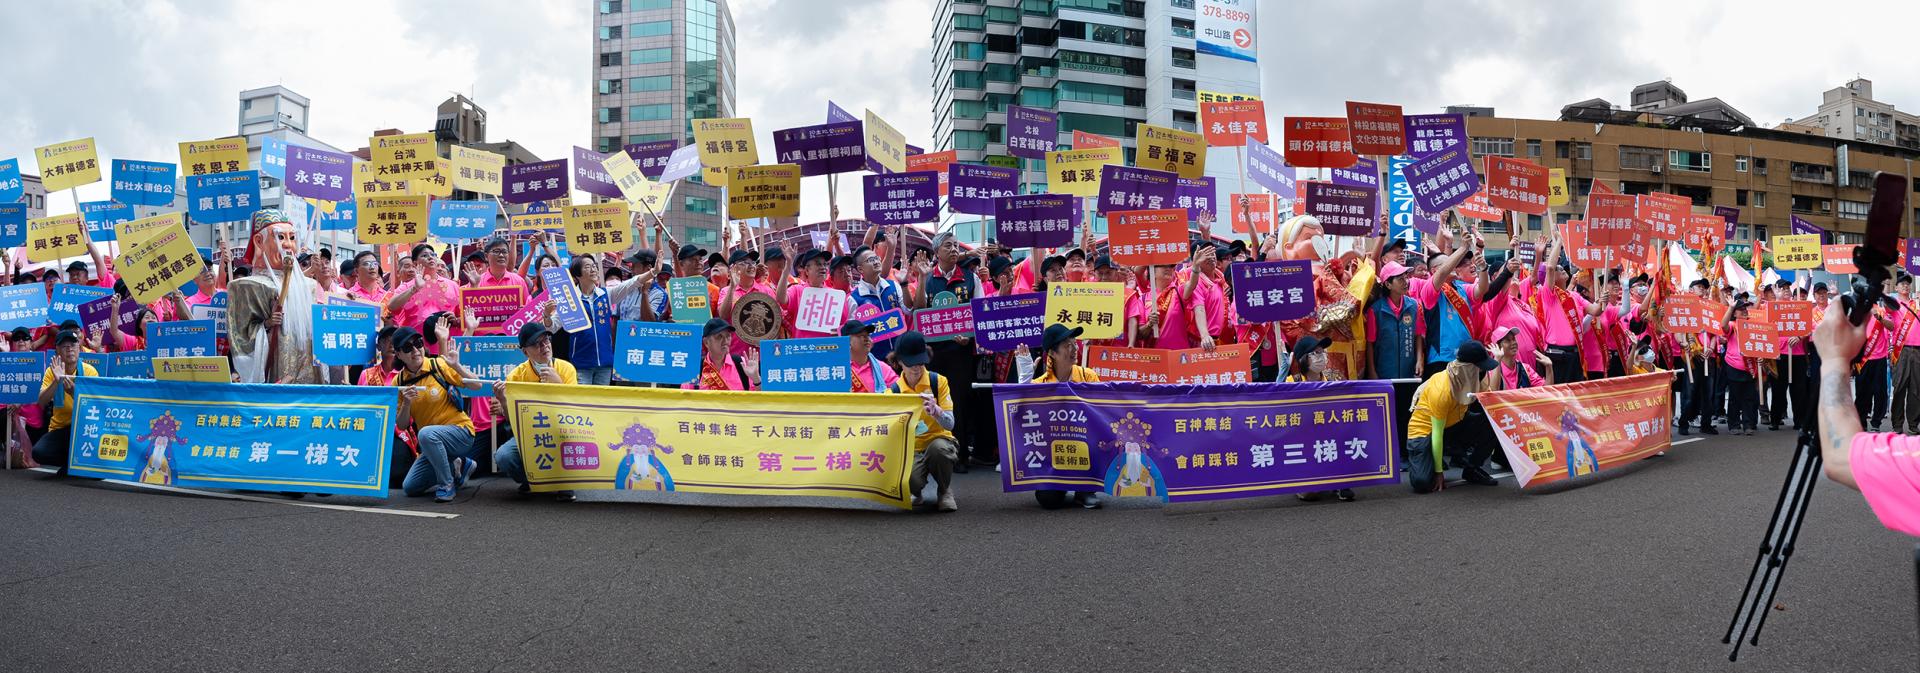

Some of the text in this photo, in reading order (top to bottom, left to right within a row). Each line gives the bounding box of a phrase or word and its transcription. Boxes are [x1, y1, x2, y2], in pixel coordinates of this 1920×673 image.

[1203, 5, 1250, 23] 378-8899
[1205, 28, 1231, 40] 中山路
[1211, 121, 1258, 135] 永佳宮
[706, 140, 748, 154] 福得宮
[1010, 135, 1053, 151] 白宮福德宮
[1289, 140, 1353, 153] 頭份福德祠
[1356, 135, 1401, 146] 文化交流協會
[1413, 138, 1458, 153] 龍德宮
[394, 149, 416, 160] 台灣
[1148, 145, 1197, 165] 晉福宮
[45, 158, 96, 178] 大有福德宮
[192, 160, 241, 176] 慈恩宮
[378, 160, 435, 175] 大福神天廟
[460, 166, 499, 183] 福興祠
[295, 170, 343, 188] 永安宮
[1061, 169, 1103, 183] 鎮溪
[1416, 163, 1470, 196] 花壇崇德宮
[115, 180, 173, 194] 舊社水頭伯公
[511, 177, 560, 194] 豐年宮
[888, 189, 915, 198] 桃園市
[953, 186, 1015, 200] 呂家土地公
[1109, 190, 1164, 210] 福林宮
[1490, 185, 1547, 205] 土地公福德會
[198, 192, 251, 211] 廣隆宮
[870, 199, 935, 212] 武田福德土地公
[1173, 196, 1208, 209] 德祠
[884, 210, 921, 221] 文化協會
[1316, 203, 1365, 215] 桃園市八德區
[438, 217, 486, 229] 鎮安宮
[584, 220, 612, 230] 桃園區
[1001, 218, 1069, 233] 林森福德祠
[1311, 214, 1372, 227] 成社區發展協會
[368, 222, 416, 235] 永安宮
[1139, 228, 1160, 239] 三芝
[34, 234, 78, 250] 興安宮
[576, 230, 622, 246] 中路宮
[1112, 242, 1188, 256] 天靈千手福德宮
[1777, 253, 1819, 263] 仁愛福德宮
[134, 253, 197, 296] 文財福德宮
[545, 271, 561, 280] 2024
[685, 280, 705, 288] 2024
[466, 293, 517, 304] TAOYUAN
[673, 281, 685, 309] 土地公
[935, 298, 953, 306] 9.07
[1246, 287, 1304, 307] 福安宮
[920, 309, 973, 324] 我愛土地公
[1057, 309, 1113, 327] 永興祠
[921, 321, 974, 335] 社區嘉年華
[988, 327, 1042, 341] 後方公園伯公
[322, 332, 368, 349] 福明宮
[626, 348, 689, 368] 南星宮
[767, 365, 846, 383] 興南福德祠
[0, 384, 28, 394] 展協會
[105, 407, 134, 420] 2024
[557, 413, 594, 427] 2024
[1048, 408, 1088, 424] 2024
[1174, 408, 1369, 433] 百神集結 千人踩街 萬人祈福
[1518, 411, 1542, 424] 2024
[196, 414, 365, 431] 百神集結 千人踩街 萬人祈福
[1049, 425, 1088, 434] TU DI GONG
[677, 420, 890, 440] 百神集結 千人踩街 萬人祈福
[102, 437, 119, 447] 民俗
[1054, 443, 1078, 454] 民俗
[190, 441, 360, 468] 會師踩街 第一梯次
[563, 445, 586, 455] 民俗
[1175, 437, 1369, 470] 會師踩街 第三梯次
[681, 450, 887, 475] 會師踩街 第二梯次
